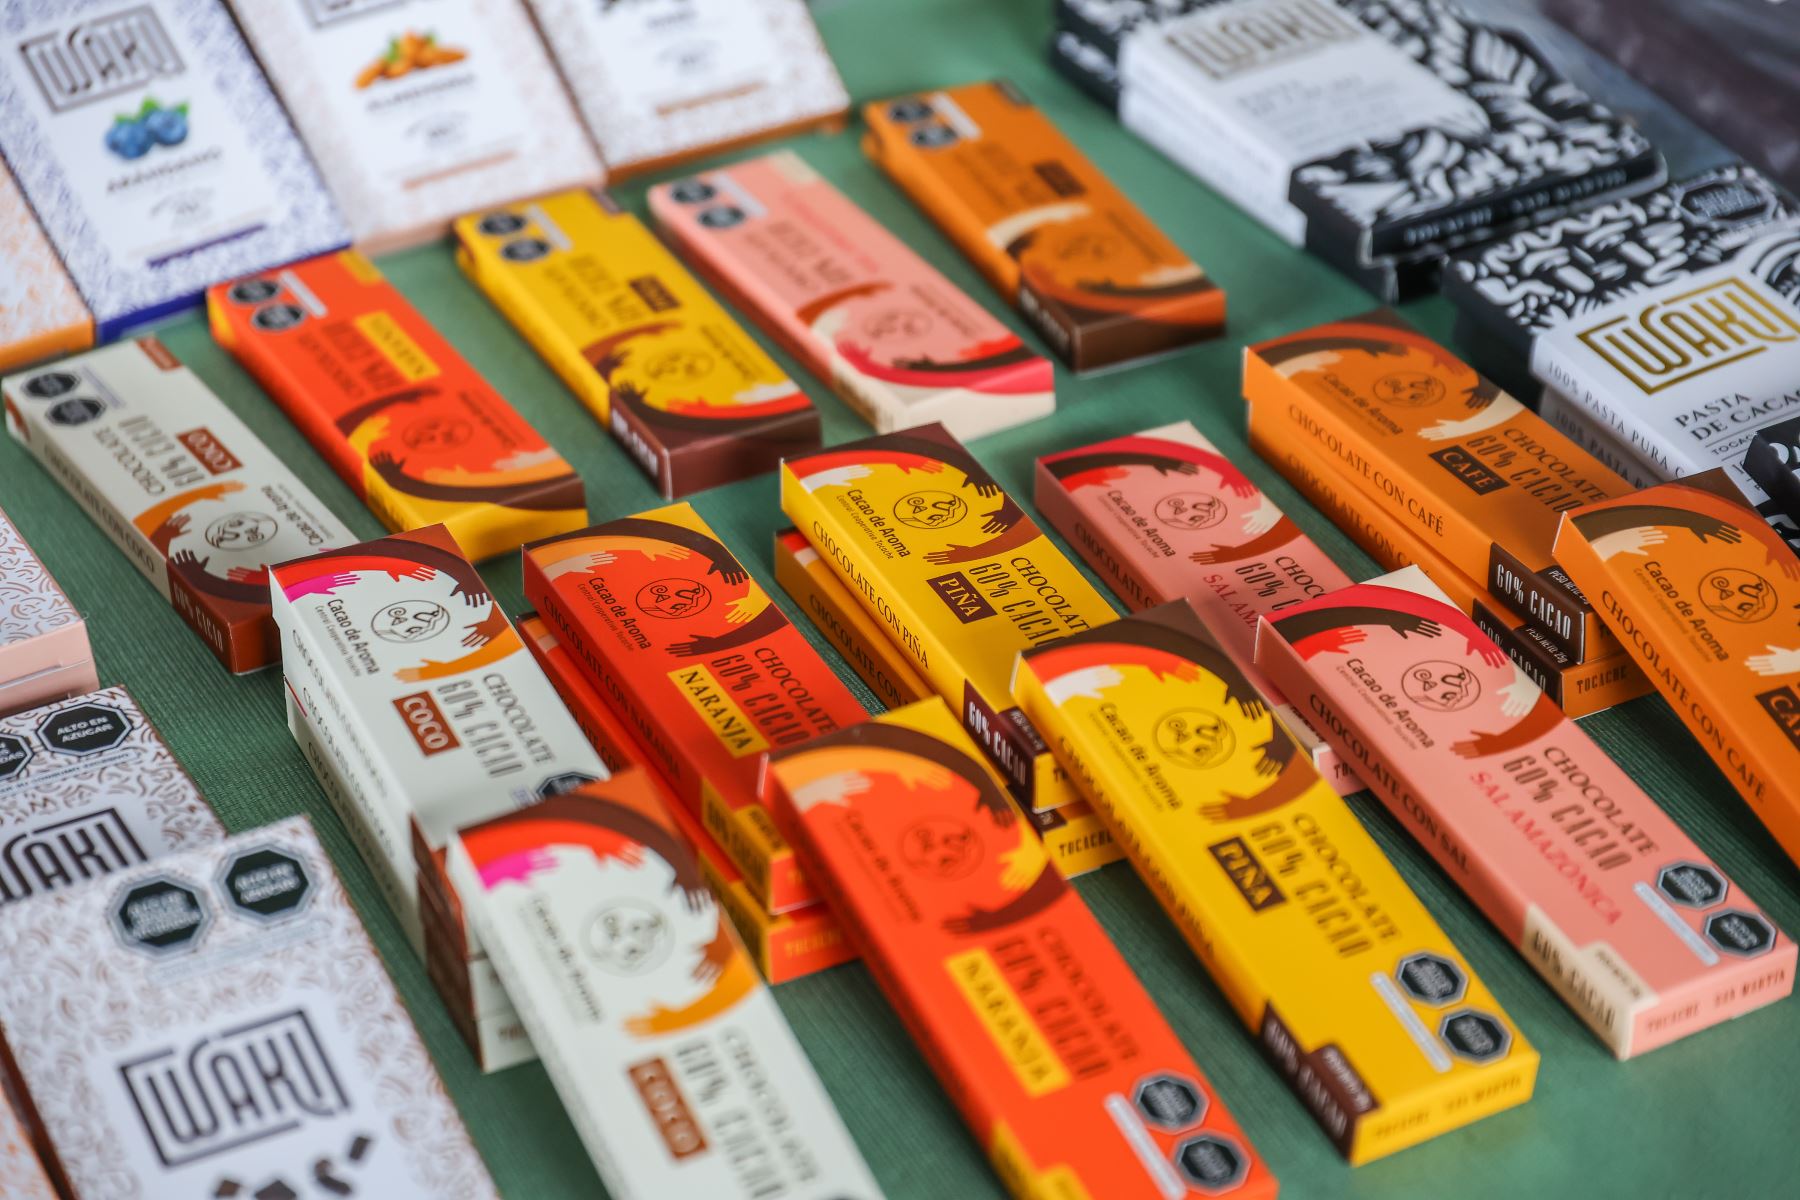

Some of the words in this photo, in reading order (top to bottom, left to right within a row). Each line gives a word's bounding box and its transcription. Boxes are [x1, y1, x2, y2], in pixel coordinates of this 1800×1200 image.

[1585, 391, 1625, 434] PASTA
[1632, 429, 1668, 470] PURA
[1674, 392, 1751, 428] PASTA
[1690, 418, 1728, 441] DE
[1289, 403, 1370, 480] CHOCOLATE
[1374, 470, 1404, 505] CON
[1408, 497, 1443, 537] CAFÉ
[1466, 435, 1517, 469] 60%
[1504, 428, 1609, 500] CHOCOLATE
[847, 489, 875, 515] Cacao
[869, 516, 886, 528] de
[879, 528, 911, 557] Aroma
[1107, 490, 1137, 516] Cacao
[1143, 528, 1176, 557] Aroma
[327, 598, 352, 628] Cacao
[588, 577, 617, 605] Cacao
[610, 605, 627, 618] de
[621, 618, 652, 650] Aroma
[813, 520, 876, 605] CHOCOLATE
[877, 596, 900, 635] CON
[902, 625, 929, 670] PIÑA
[938, 577, 982, 617] PIÑA
[968, 562, 1023, 598] 60%
[1010, 557, 1091, 632] CHOCOLAT
[1203, 574, 1238, 601] SAL
[1235, 562, 1289, 598] 60%
[1497, 562, 1524, 604] 60%
[1530, 590, 1571, 640] CACAO
[1644, 560, 1680, 599] Cacao
[1675, 599, 1694, 617] de
[1689, 618, 1730, 661] Aroma
[344, 628, 362, 642] de
[352, 641, 380, 675] Aroma
[810, 593, 876, 679] CHOCOLATE
[1602, 590, 1690, 702] CHOCOLATE
[1691, 703, 1725, 751] CON
[402, 696, 449, 749] COCO
[483, 672, 556, 765] CHOCOLATE
[680, 670, 753, 750] NARANJA
[711, 653, 765, 692] 60%
[743, 692, 811, 746] CACAO
[754, 647, 841, 736] CHOCOLATE
[1346, 657, 1382, 693] Cacao
[1379, 691, 1397, 709] de
[1394, 709, 1435, 750] Aroma
[1311, 692, 1400, 794] CHOCOLATE
[1403, 791, 1439, 839] CON
[1544, 746, 1660, 855] CHOCOLATE
[1502, 755, 1560, 803] 60%
[1551, 803, 1632, 872] CACAO
[120, 1009, 351, 1167] WAKU
